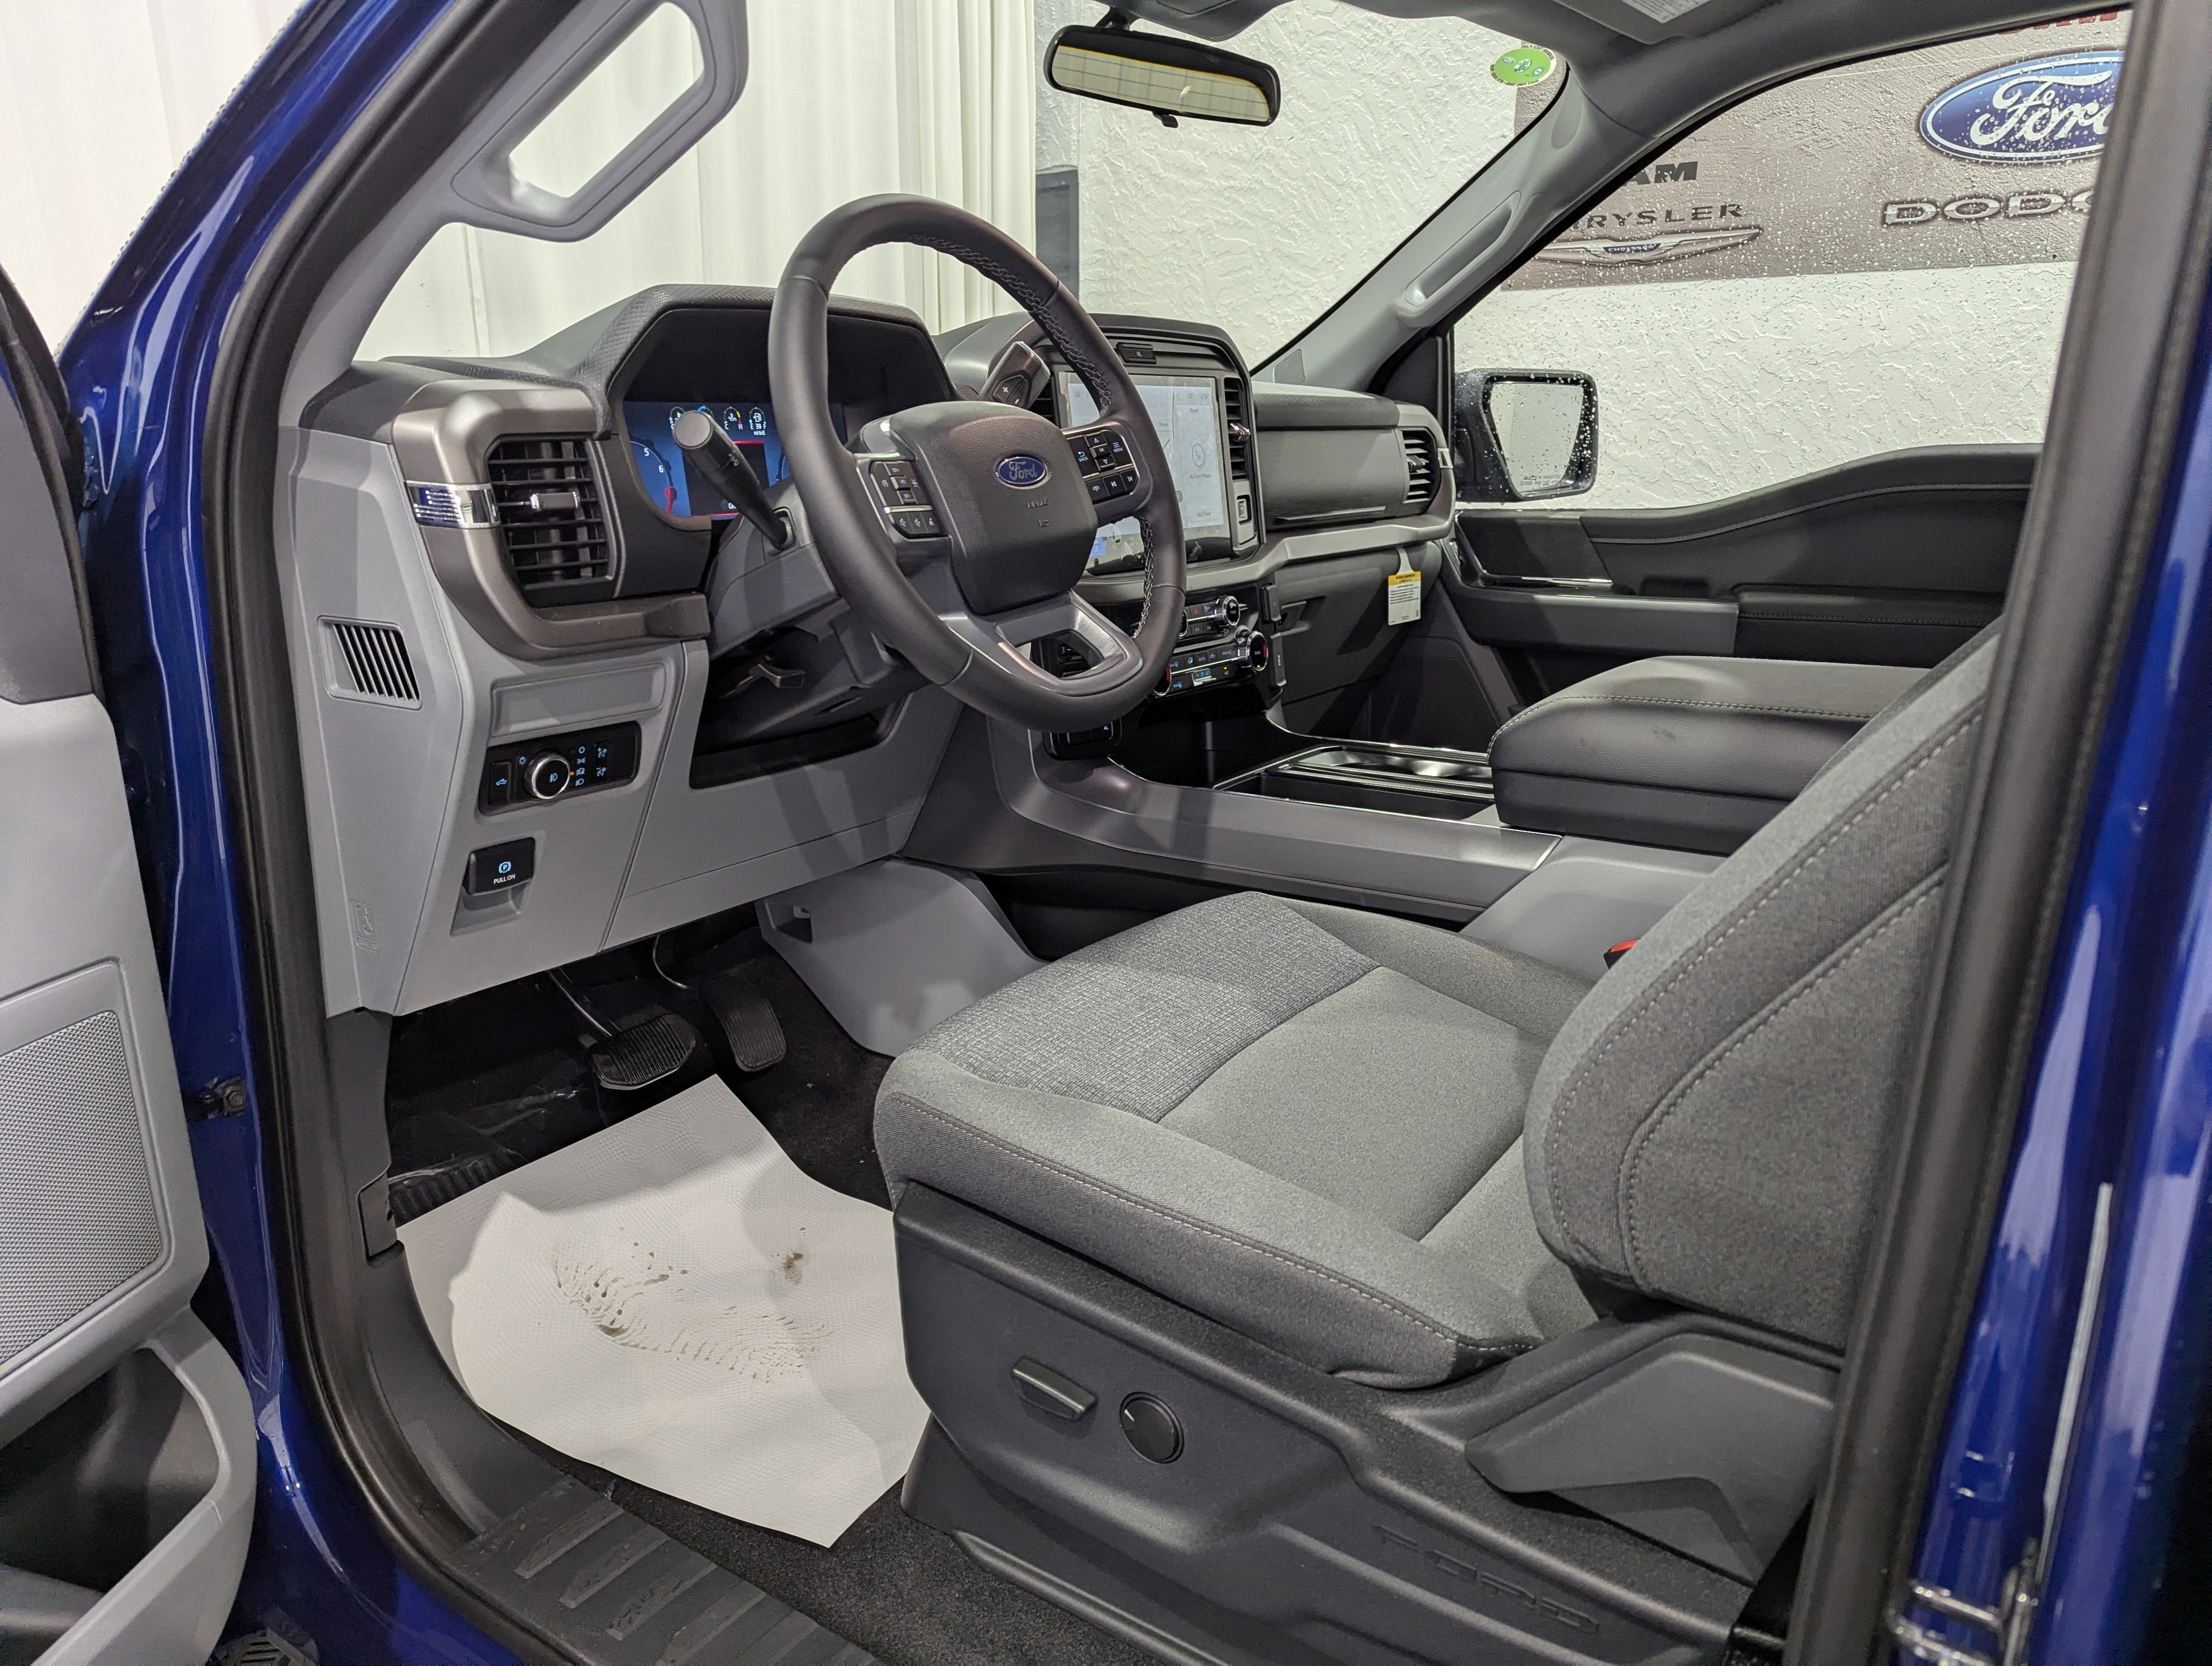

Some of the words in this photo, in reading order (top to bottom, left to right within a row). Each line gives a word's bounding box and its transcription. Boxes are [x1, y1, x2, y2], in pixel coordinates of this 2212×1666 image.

[1625, 161, 1698, 185] AM
[1573, 203, 1744, 229] RYSLER
[1883, 189, 2095, 224] DOD
[644, 447, 650, 457] 5
[658, 465, 664, 473] 6
[1008, 461, 1038, 480] Ford
[493, 876, 507, 885] PULL
